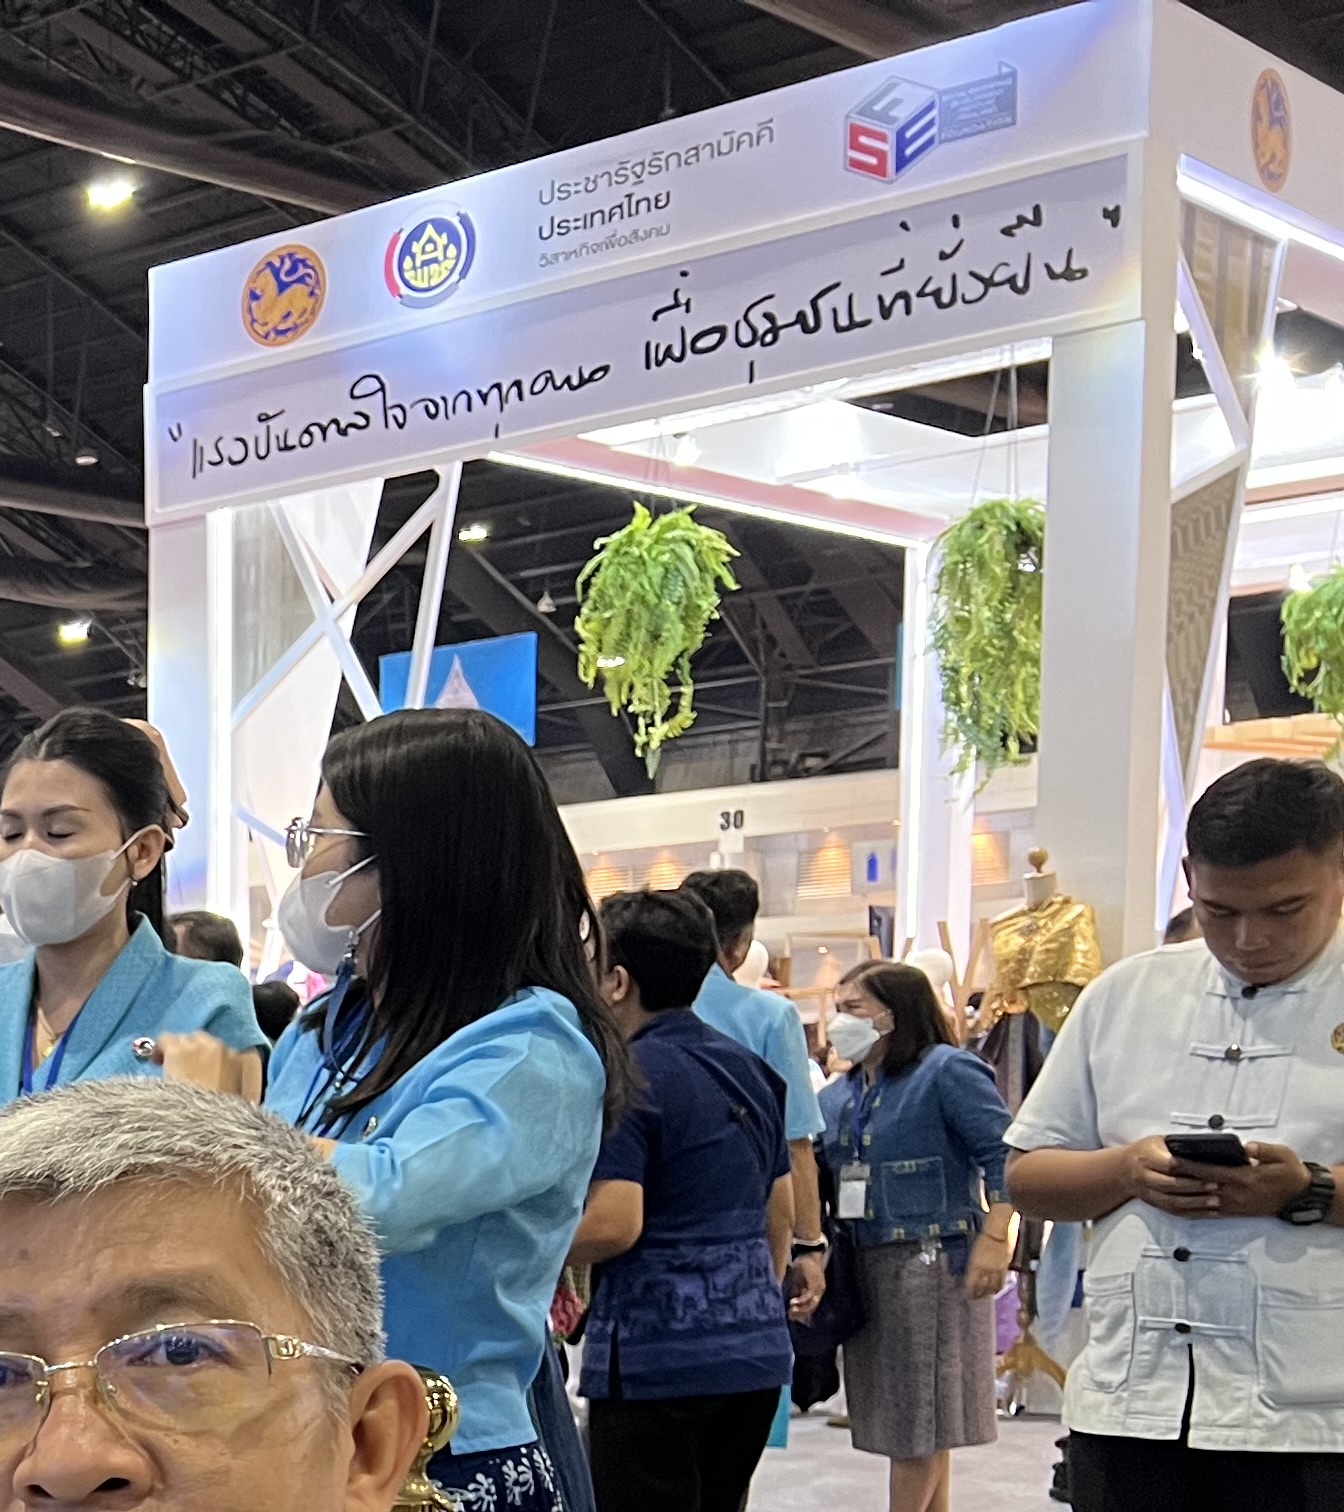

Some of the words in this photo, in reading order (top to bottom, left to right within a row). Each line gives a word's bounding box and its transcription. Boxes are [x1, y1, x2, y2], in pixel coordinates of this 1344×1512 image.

[538, 117, 774, 206] ประชารัฐรักสามัคคี
[538, 190, 672, 241] ประเทศไทย
[719, 809, 745, 831] 30
